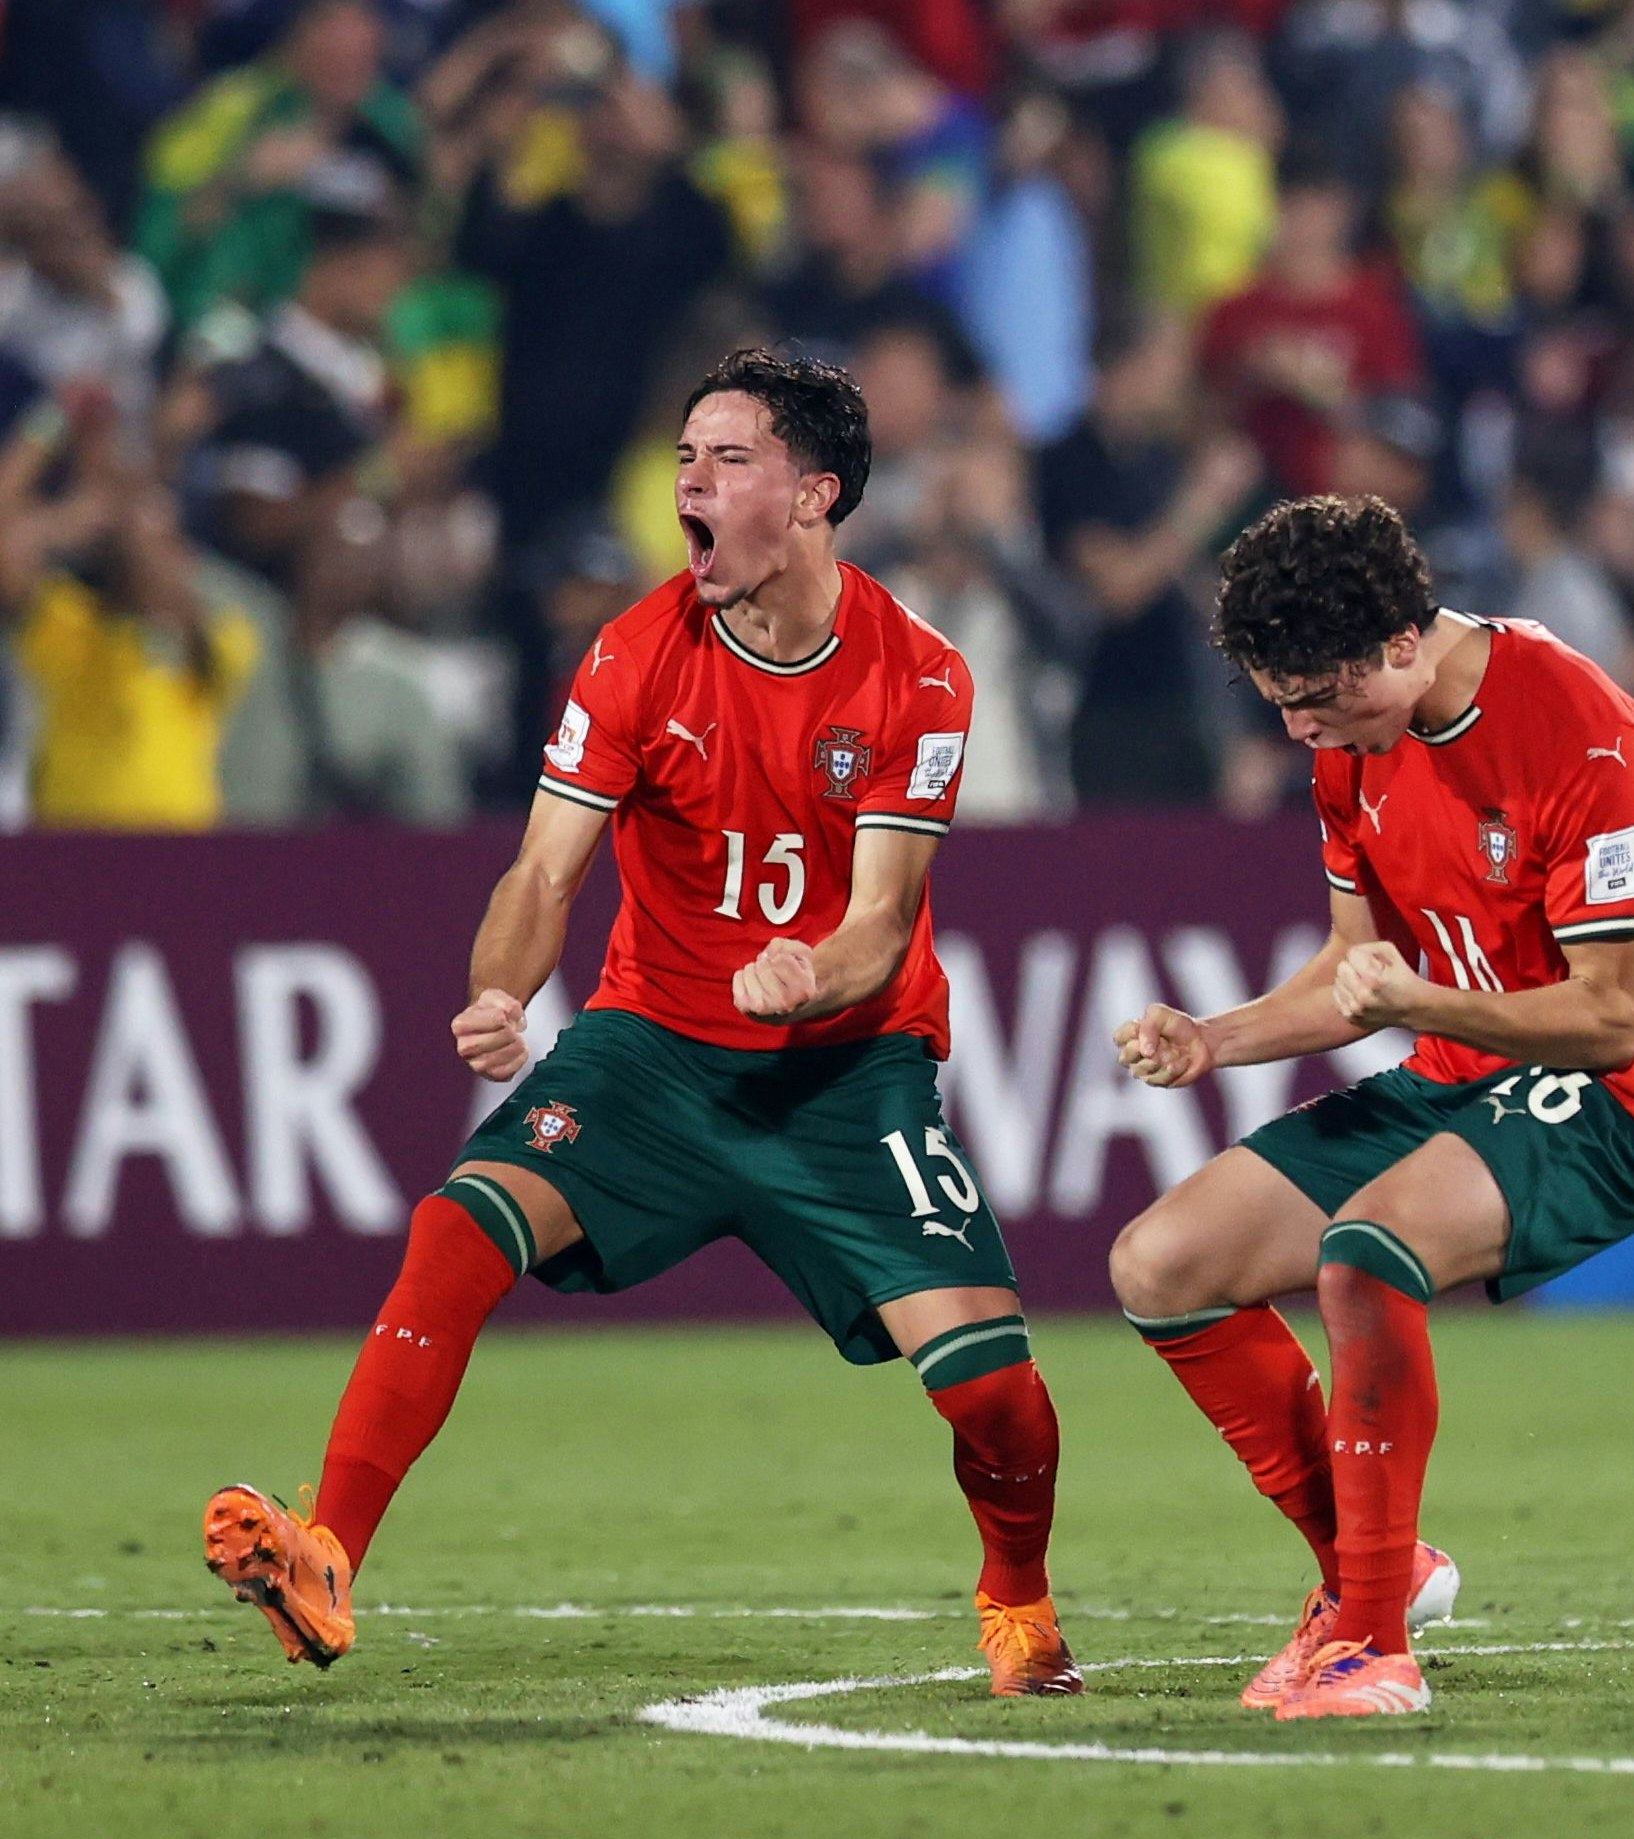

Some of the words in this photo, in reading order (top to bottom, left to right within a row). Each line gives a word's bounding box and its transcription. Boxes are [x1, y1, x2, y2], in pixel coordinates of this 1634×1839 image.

[1599, 842, 1630, 856] FOOTBALL
[1599, 852, 1631, 868] UNITES
[713, 829, 806, 925] 15
[879, 1125, 980, 1218] 15
